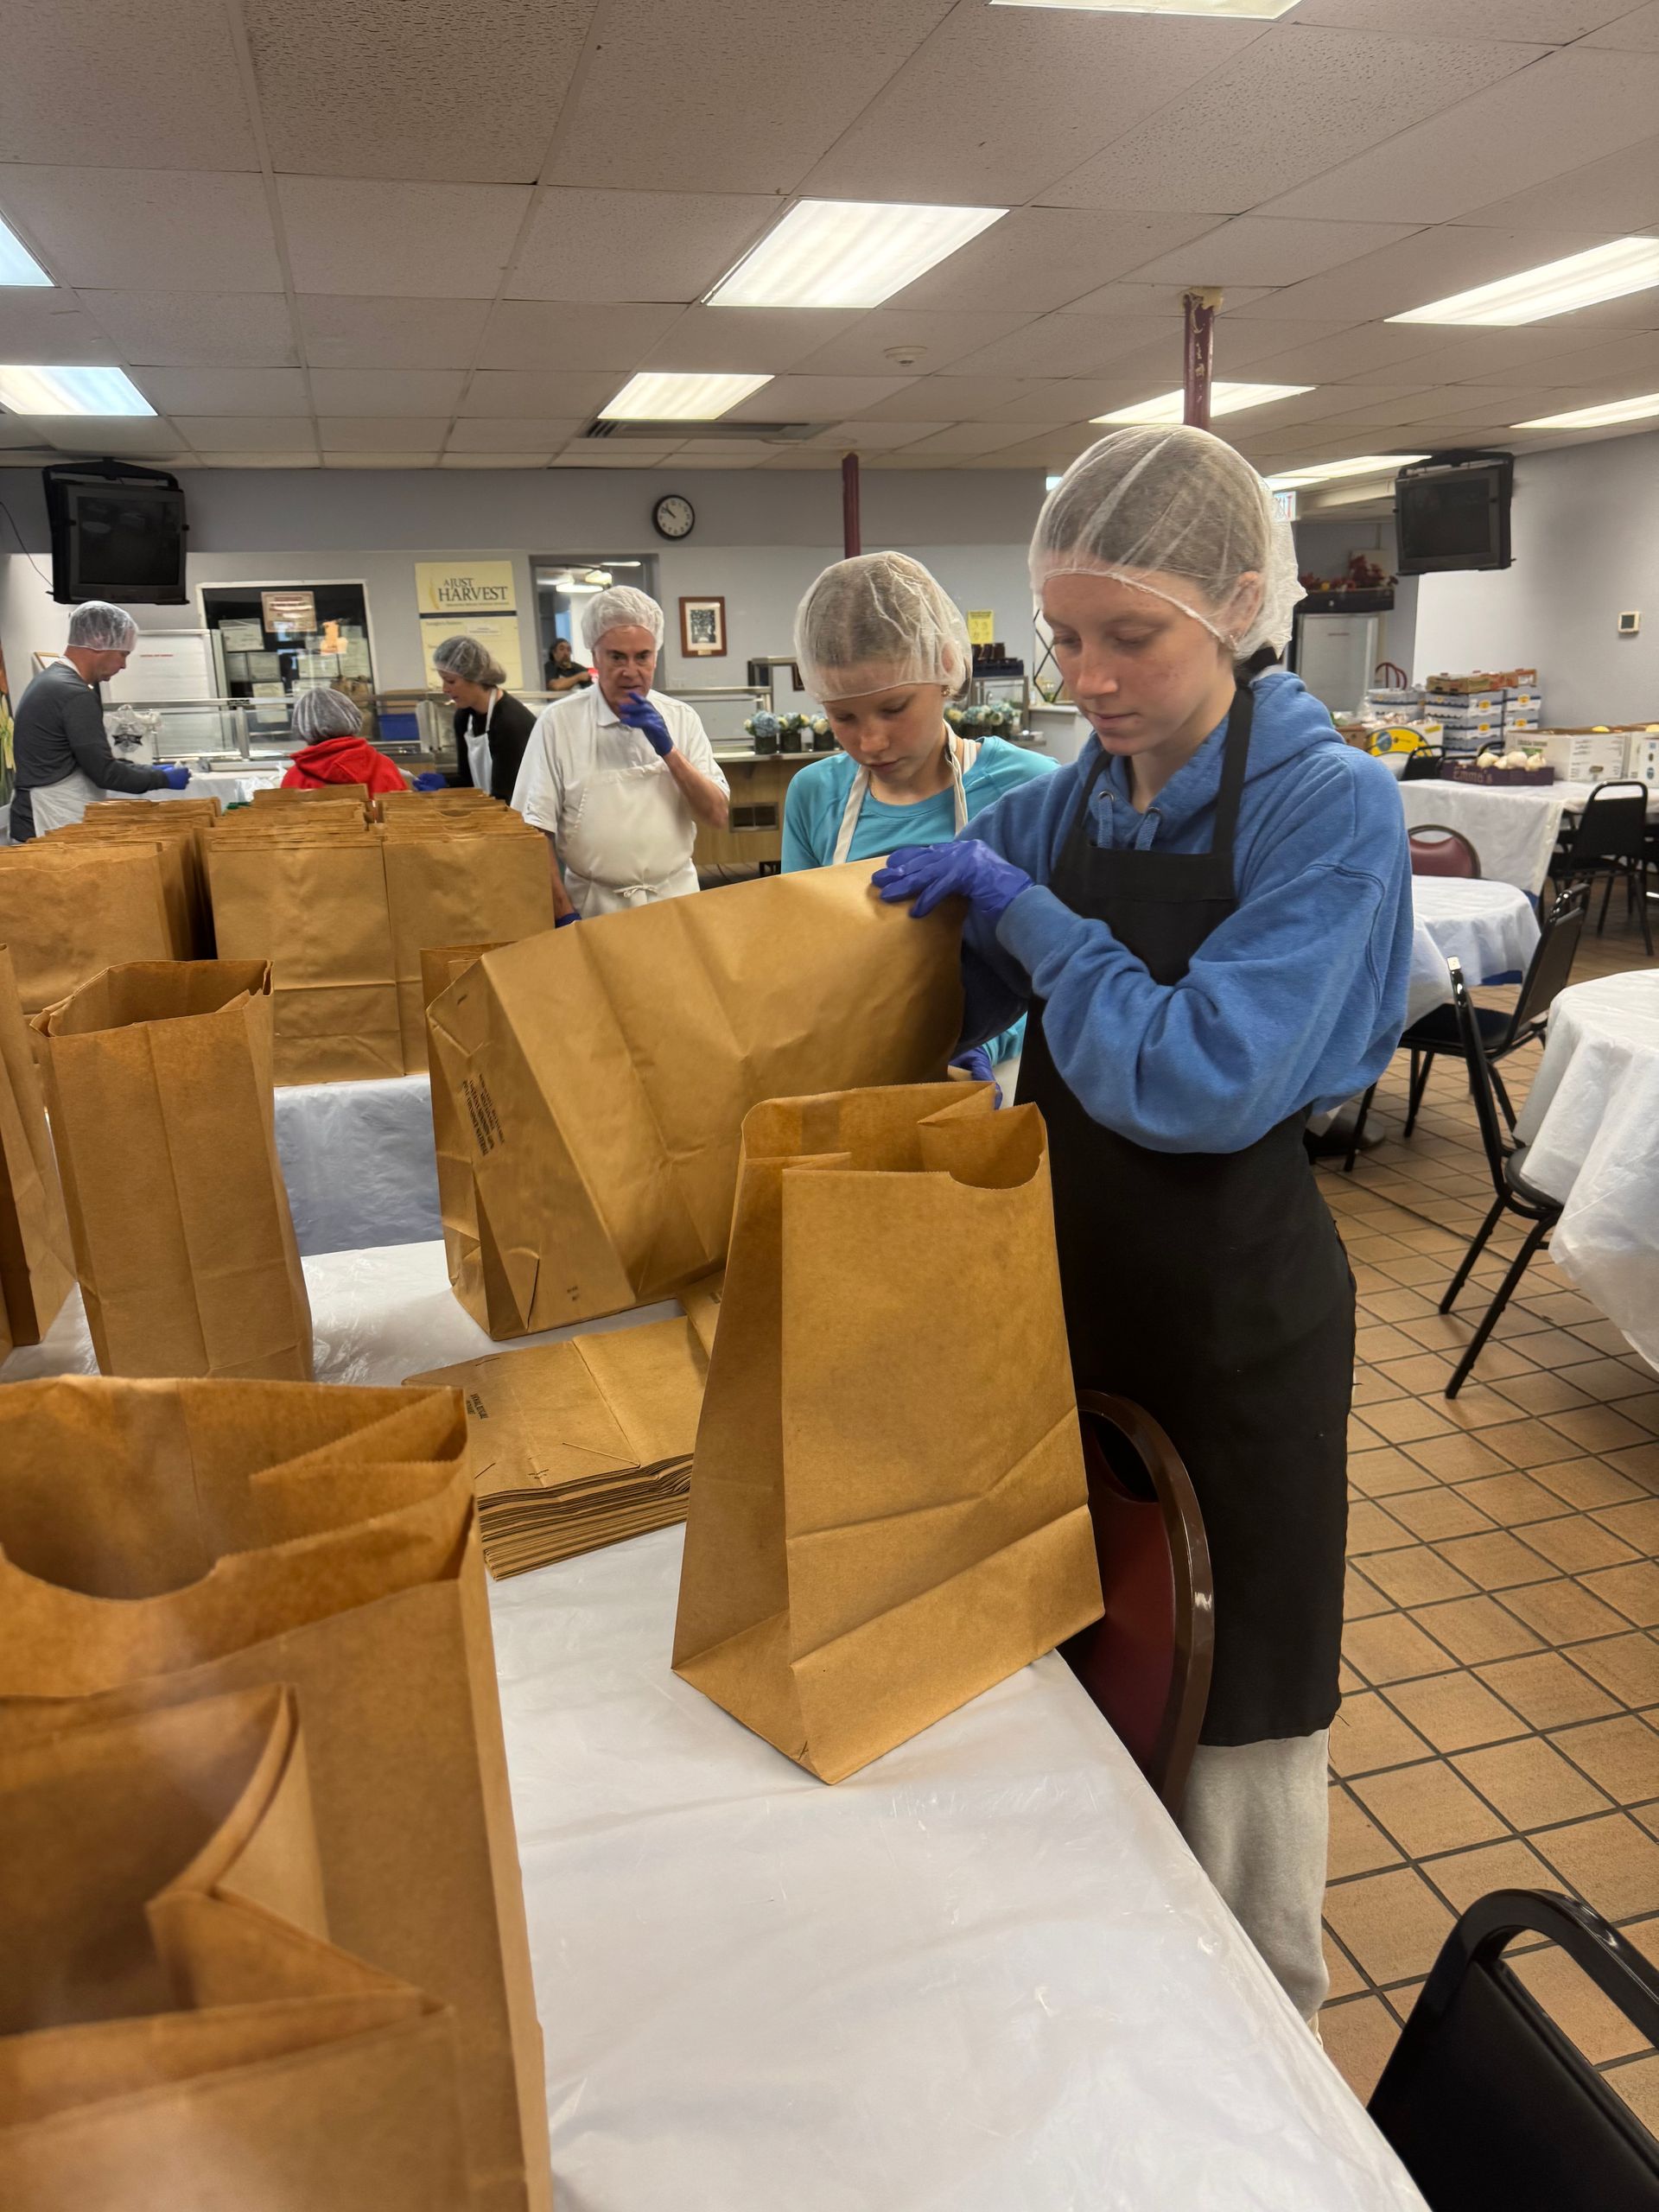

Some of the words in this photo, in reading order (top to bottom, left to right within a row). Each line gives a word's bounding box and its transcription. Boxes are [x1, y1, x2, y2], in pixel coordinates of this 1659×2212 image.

[443, 579, 450, 588] A
[450, 577, 474, 590] JUST
[438, 586, 508, 602] HARVEST
